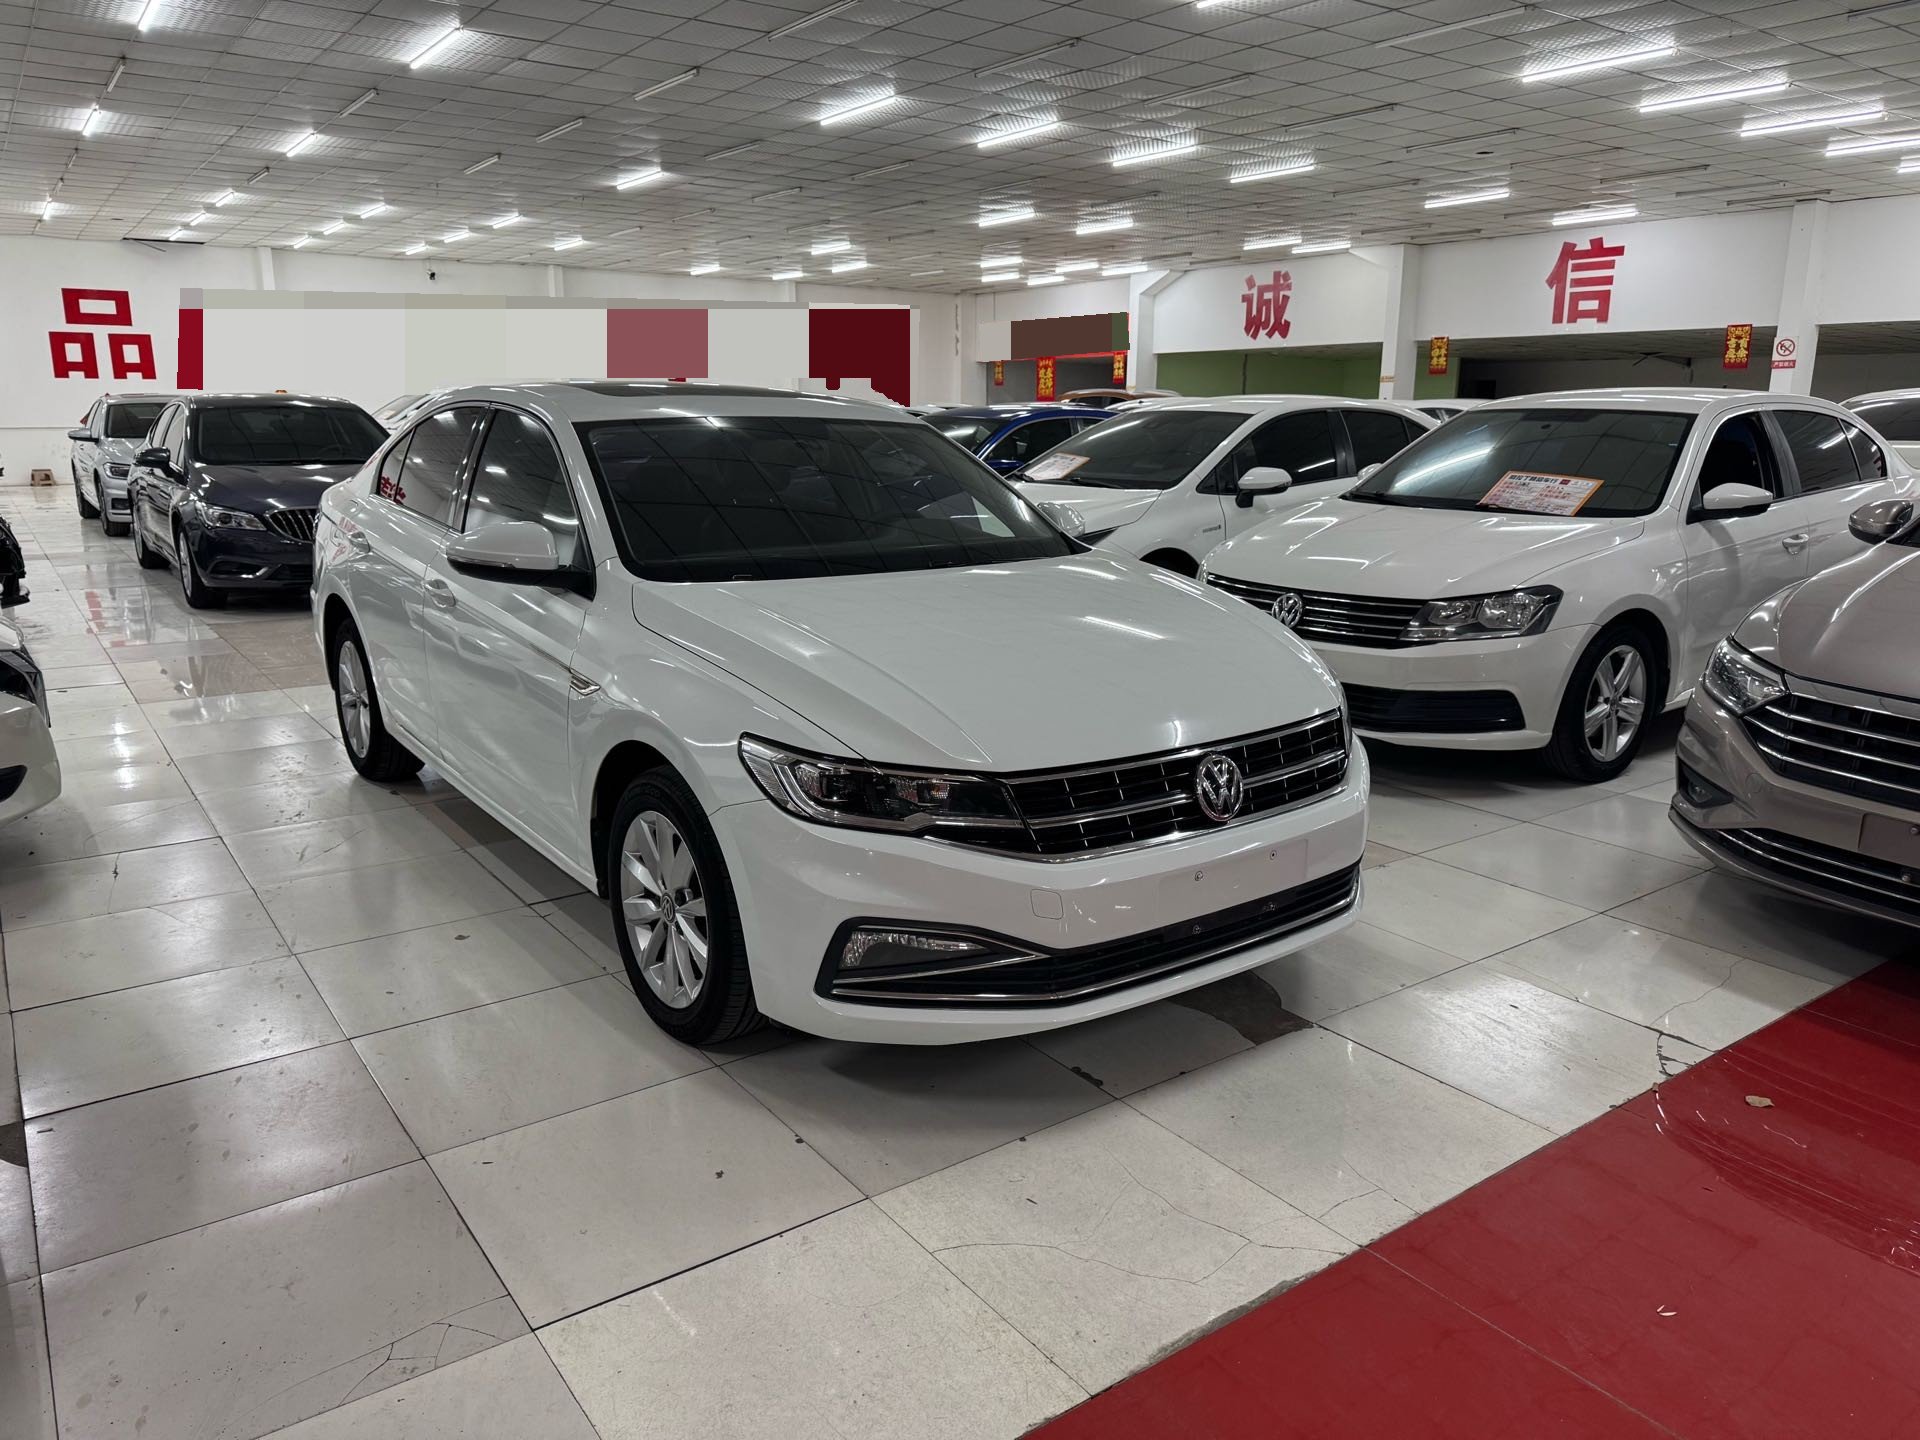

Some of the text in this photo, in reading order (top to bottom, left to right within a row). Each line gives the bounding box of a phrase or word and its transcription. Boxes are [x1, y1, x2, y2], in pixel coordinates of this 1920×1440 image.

[1241, 270, 1292, 340] 诚
[1545, 237, 1625, 324] 信
[48, 288, 157, 380] 品
